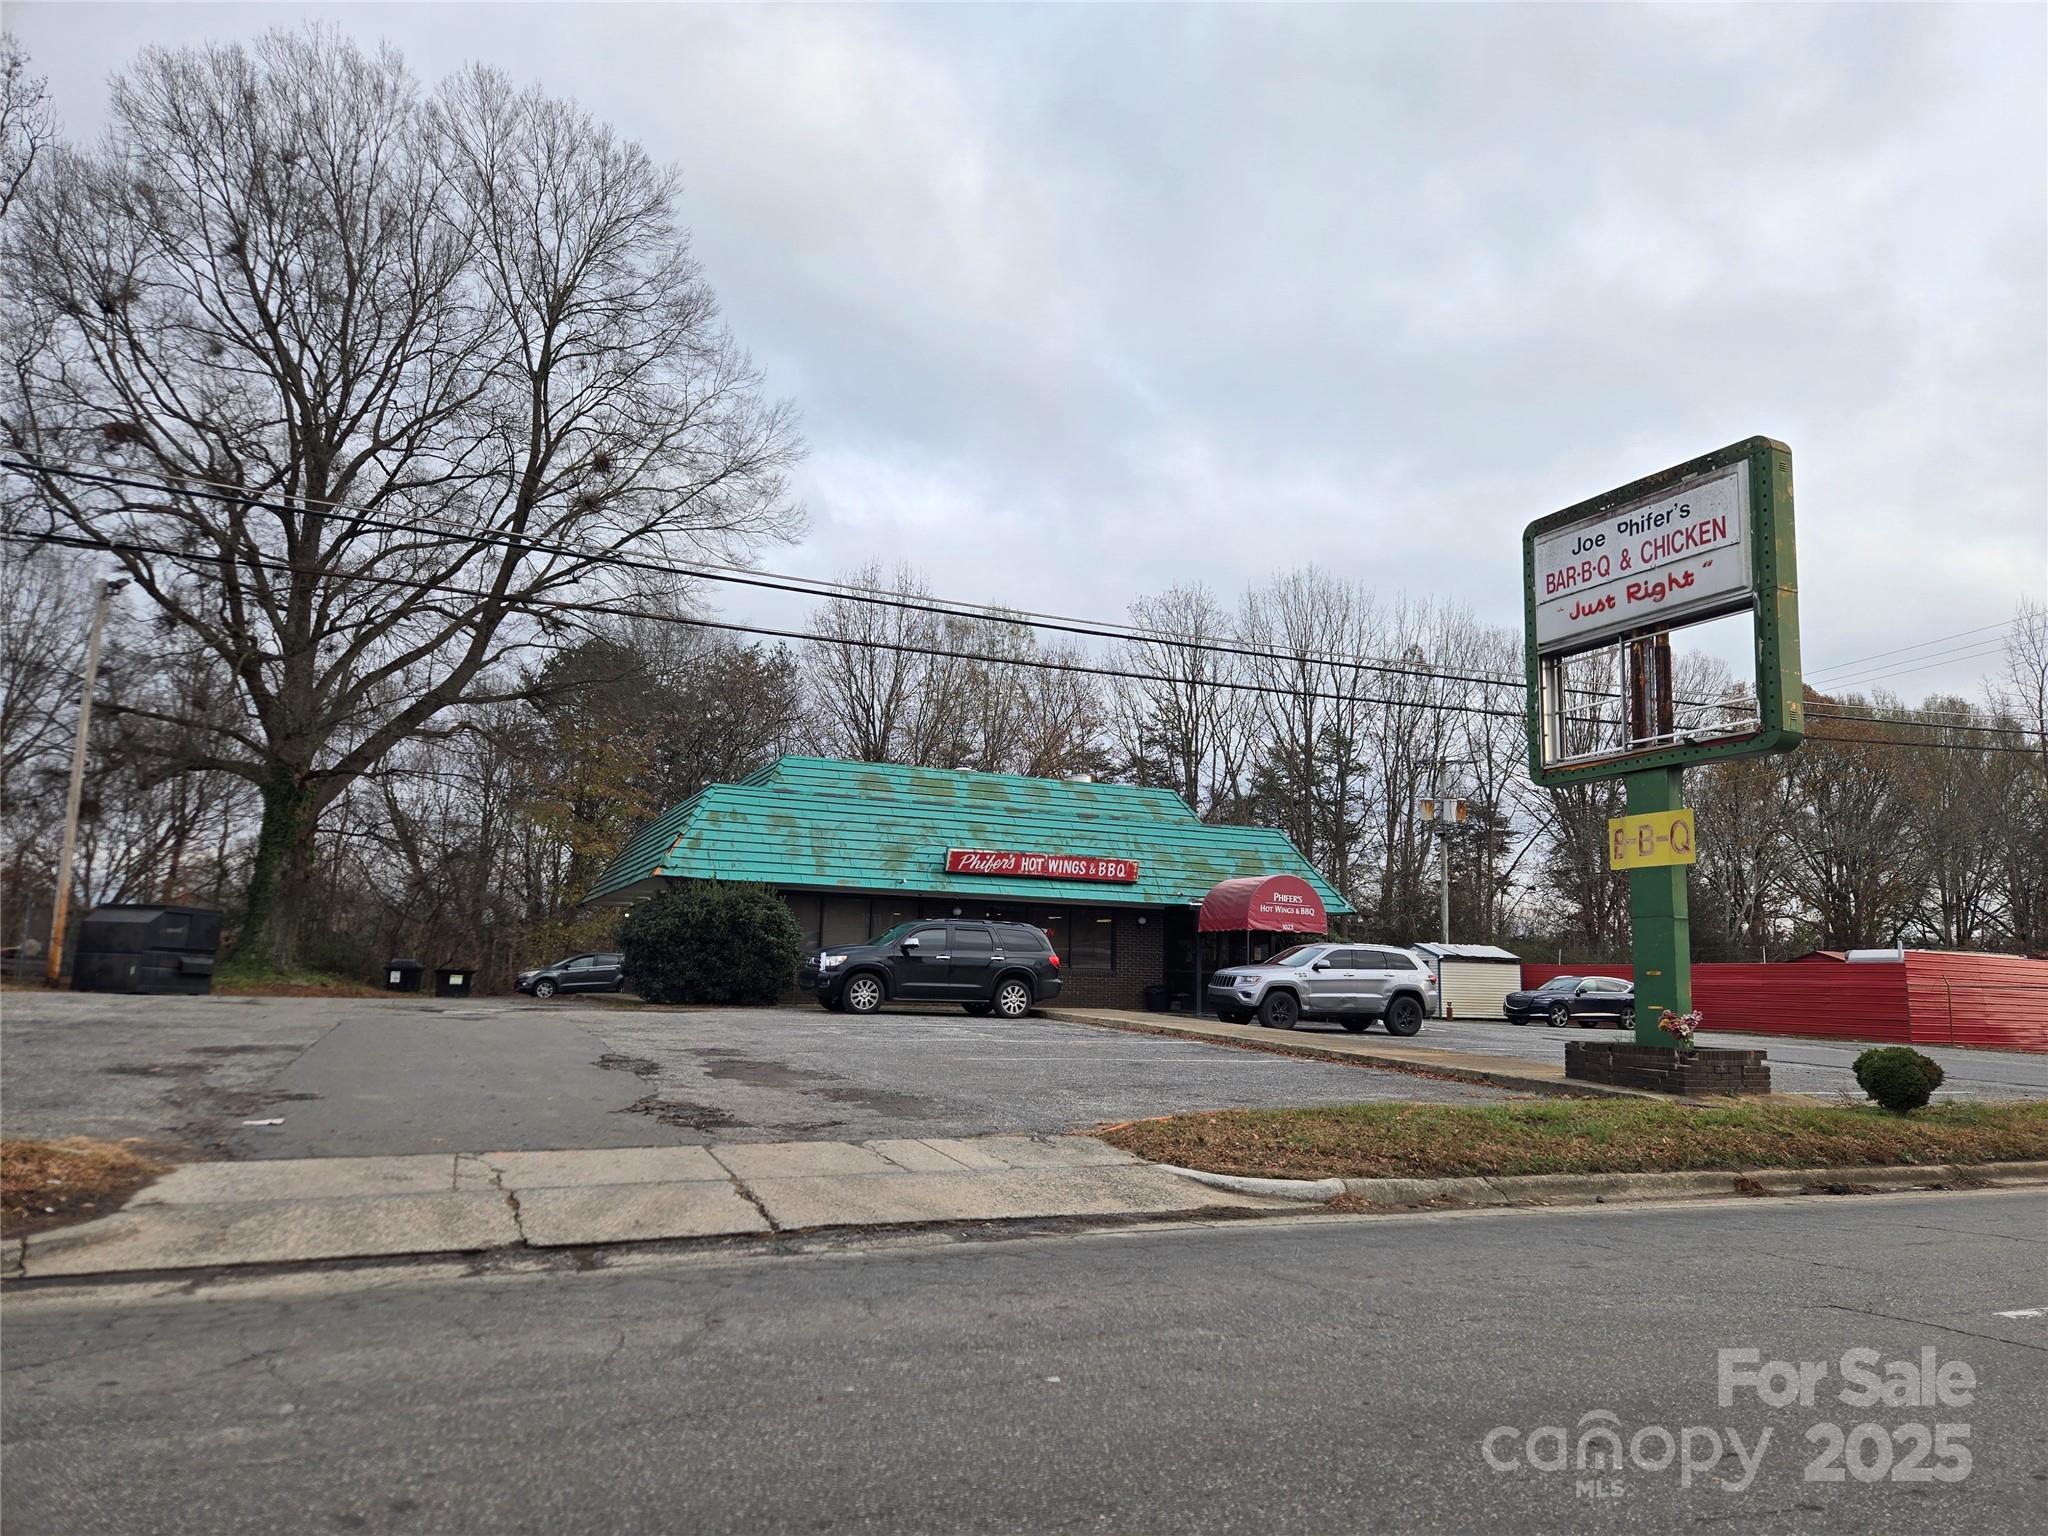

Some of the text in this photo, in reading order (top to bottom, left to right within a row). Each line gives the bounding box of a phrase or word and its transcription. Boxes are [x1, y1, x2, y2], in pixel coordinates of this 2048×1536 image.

[1572, 533, 1606, 555] Joe
[1620, 548, 1632, 571] &
[1640, 515, 1727, 564] CHICKEN
[958, 853, 1126, 878] Phifer's HOT WINGS & BBQ
[1300, 907, 1315, 916] BBQ
